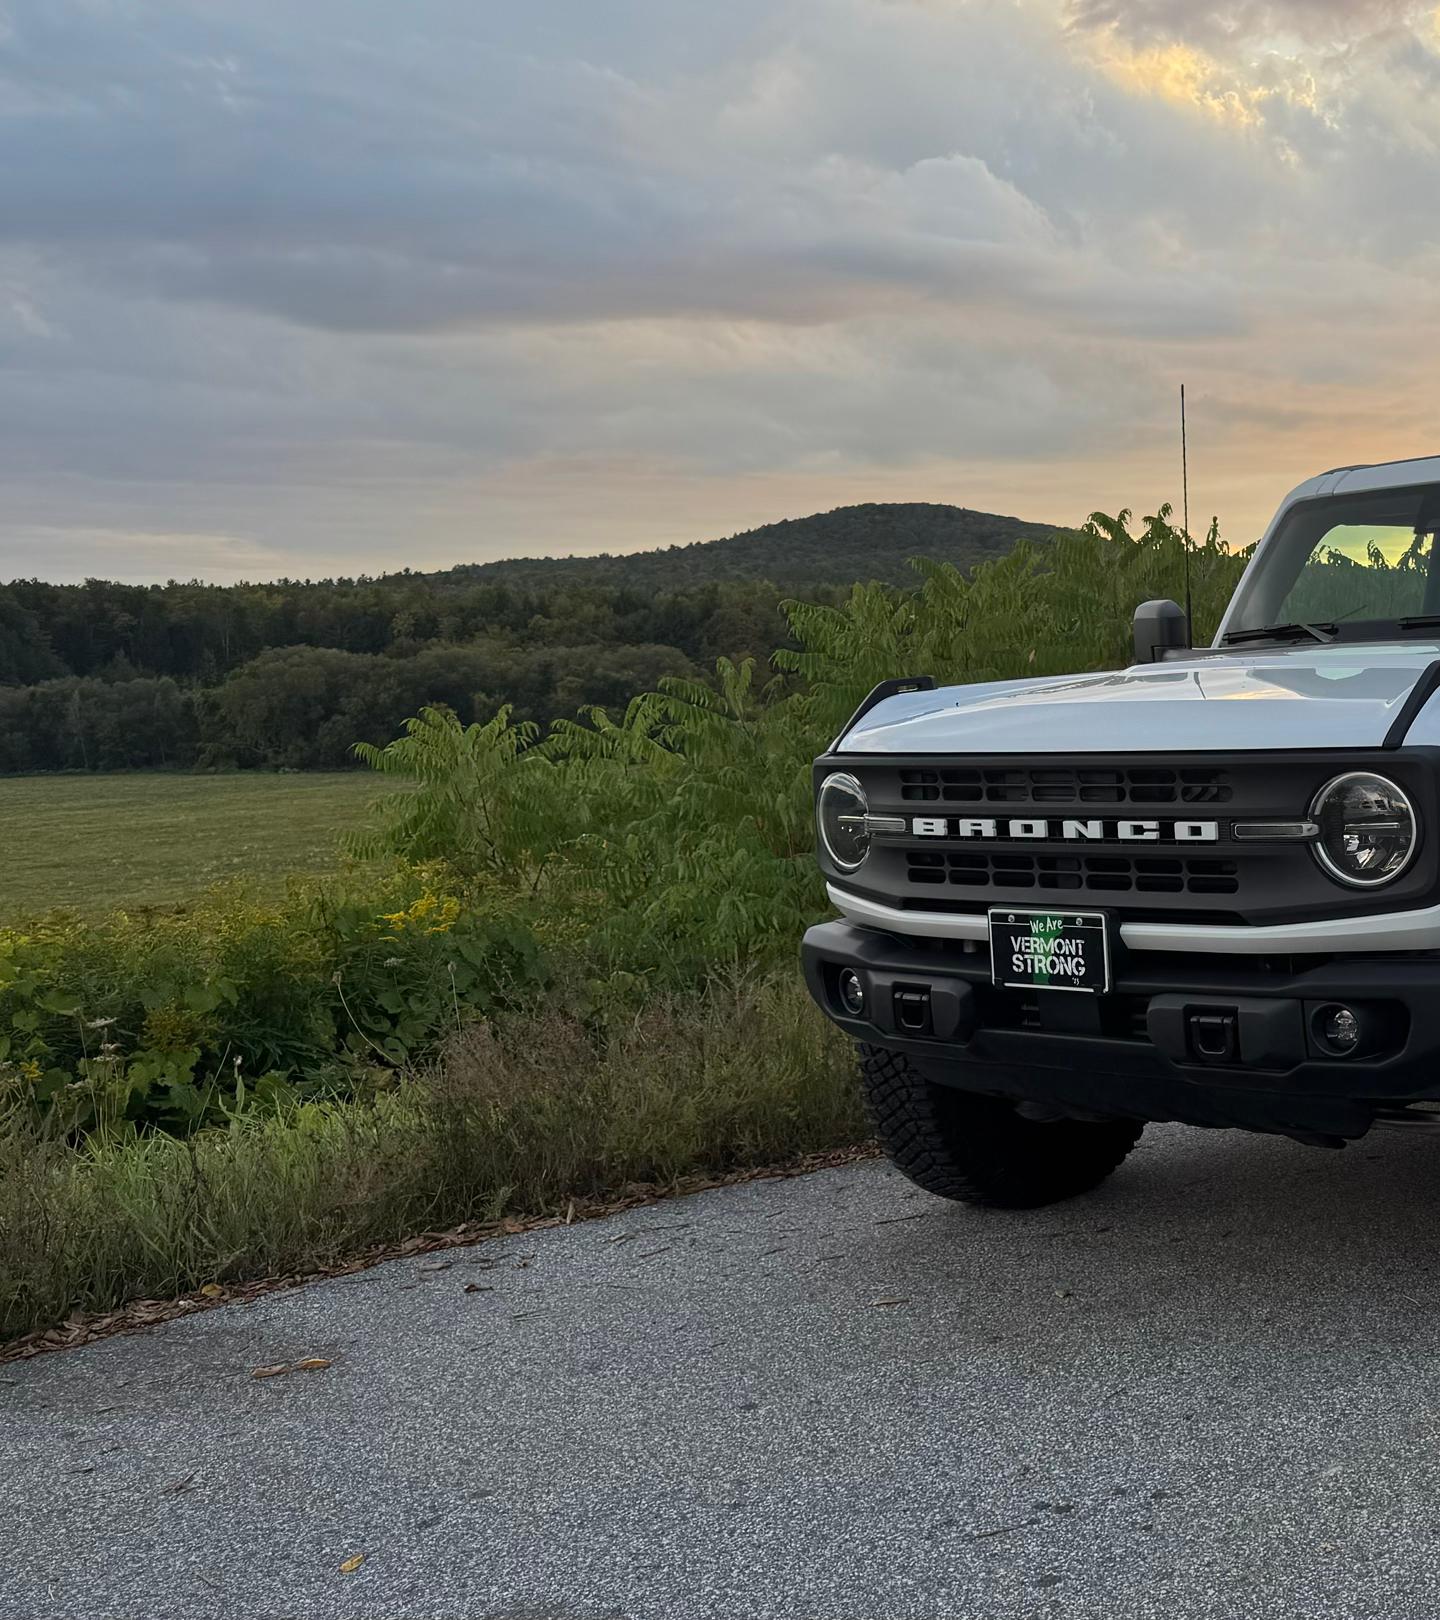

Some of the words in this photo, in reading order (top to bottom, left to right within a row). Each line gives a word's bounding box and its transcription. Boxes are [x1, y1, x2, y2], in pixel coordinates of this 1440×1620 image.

[912, 817, 1219, 841] BRONCO
[1029, 920, 1045, 934] We
[1046, 916, 1064, 933] Are
[1010, 936, 1085, 956] VERMONT
[1012, 953, 1086, 977] STRONG
